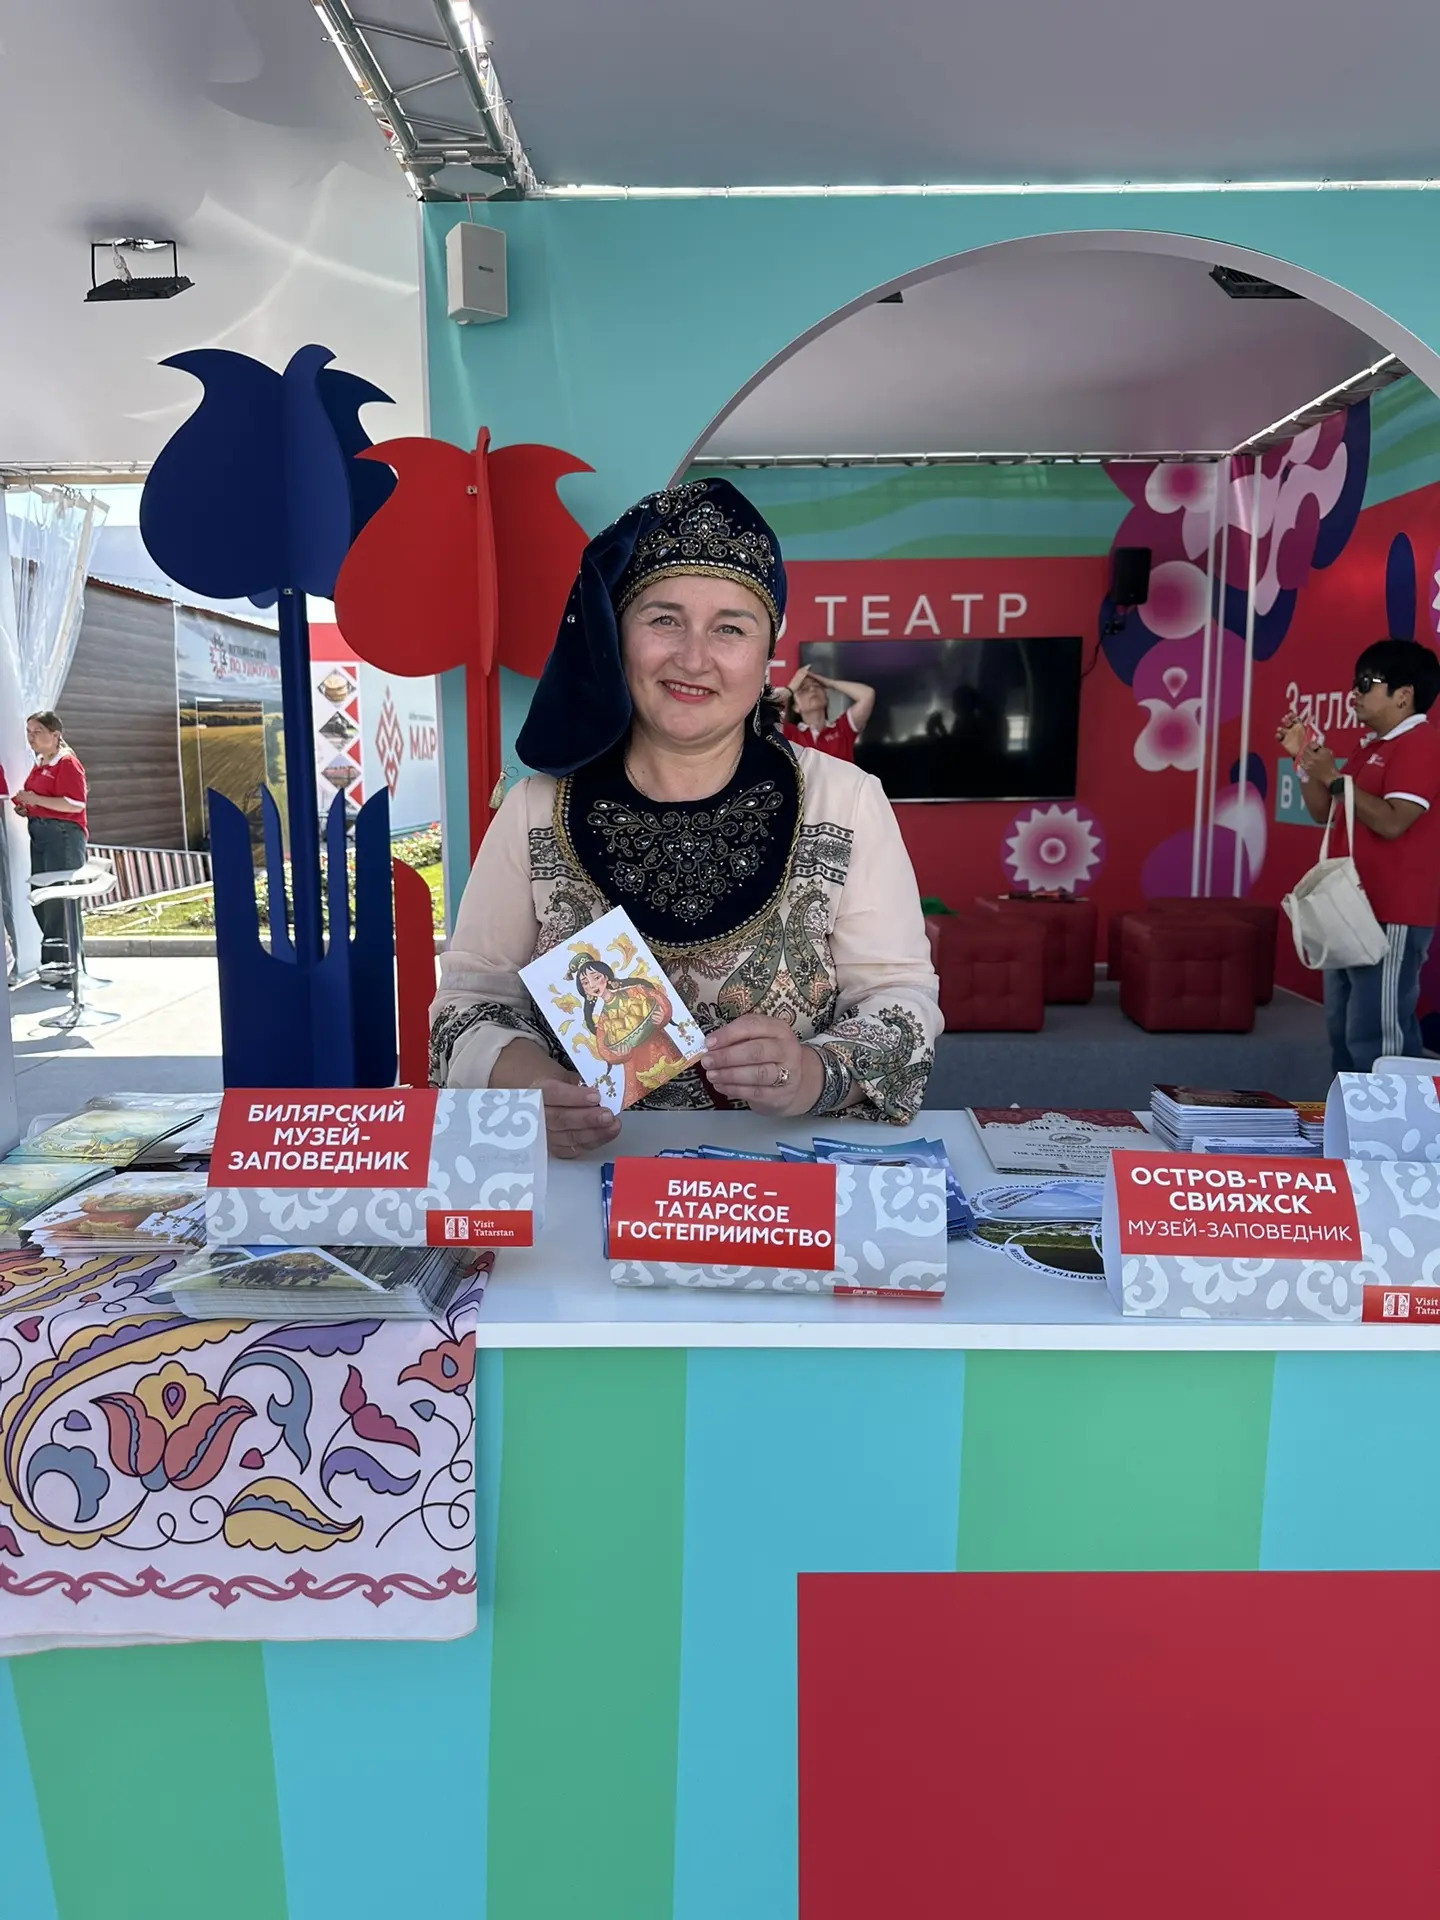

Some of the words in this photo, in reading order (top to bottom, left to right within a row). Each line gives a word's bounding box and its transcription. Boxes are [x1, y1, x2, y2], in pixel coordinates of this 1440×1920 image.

[814, 593, 1028, 636] ТЕАТР
[248, 1100, 405, 1122] БИЛЯРСКИЙ
[273, 1123, 371, 1146] МУЗЕЙ-
[228, 1151, 410, 1173] ЗАПОВЕДНИК
[667, 1179, 757, 1199] БИБАРС
[1130, 1167, 1337, 1193] ОСТРОВ-ГРАД
[655, 1200, 790, 1223] ТАТАРСКОЕ
[1169, 1191, 1312, 1214] СВИЯЖСК
[473, 1220, 495, 1228] Visit
[474, 1228, 515, 1237] Tatarstan
[617, 1220, 832, 1248] ГОСТЕПРИИМСТВО
[1128, 1218, 1353, 1243] МУЗЕЙ-ЗАПОВЕДНИК
[1414, 1297, 1439, 1306] Visit
